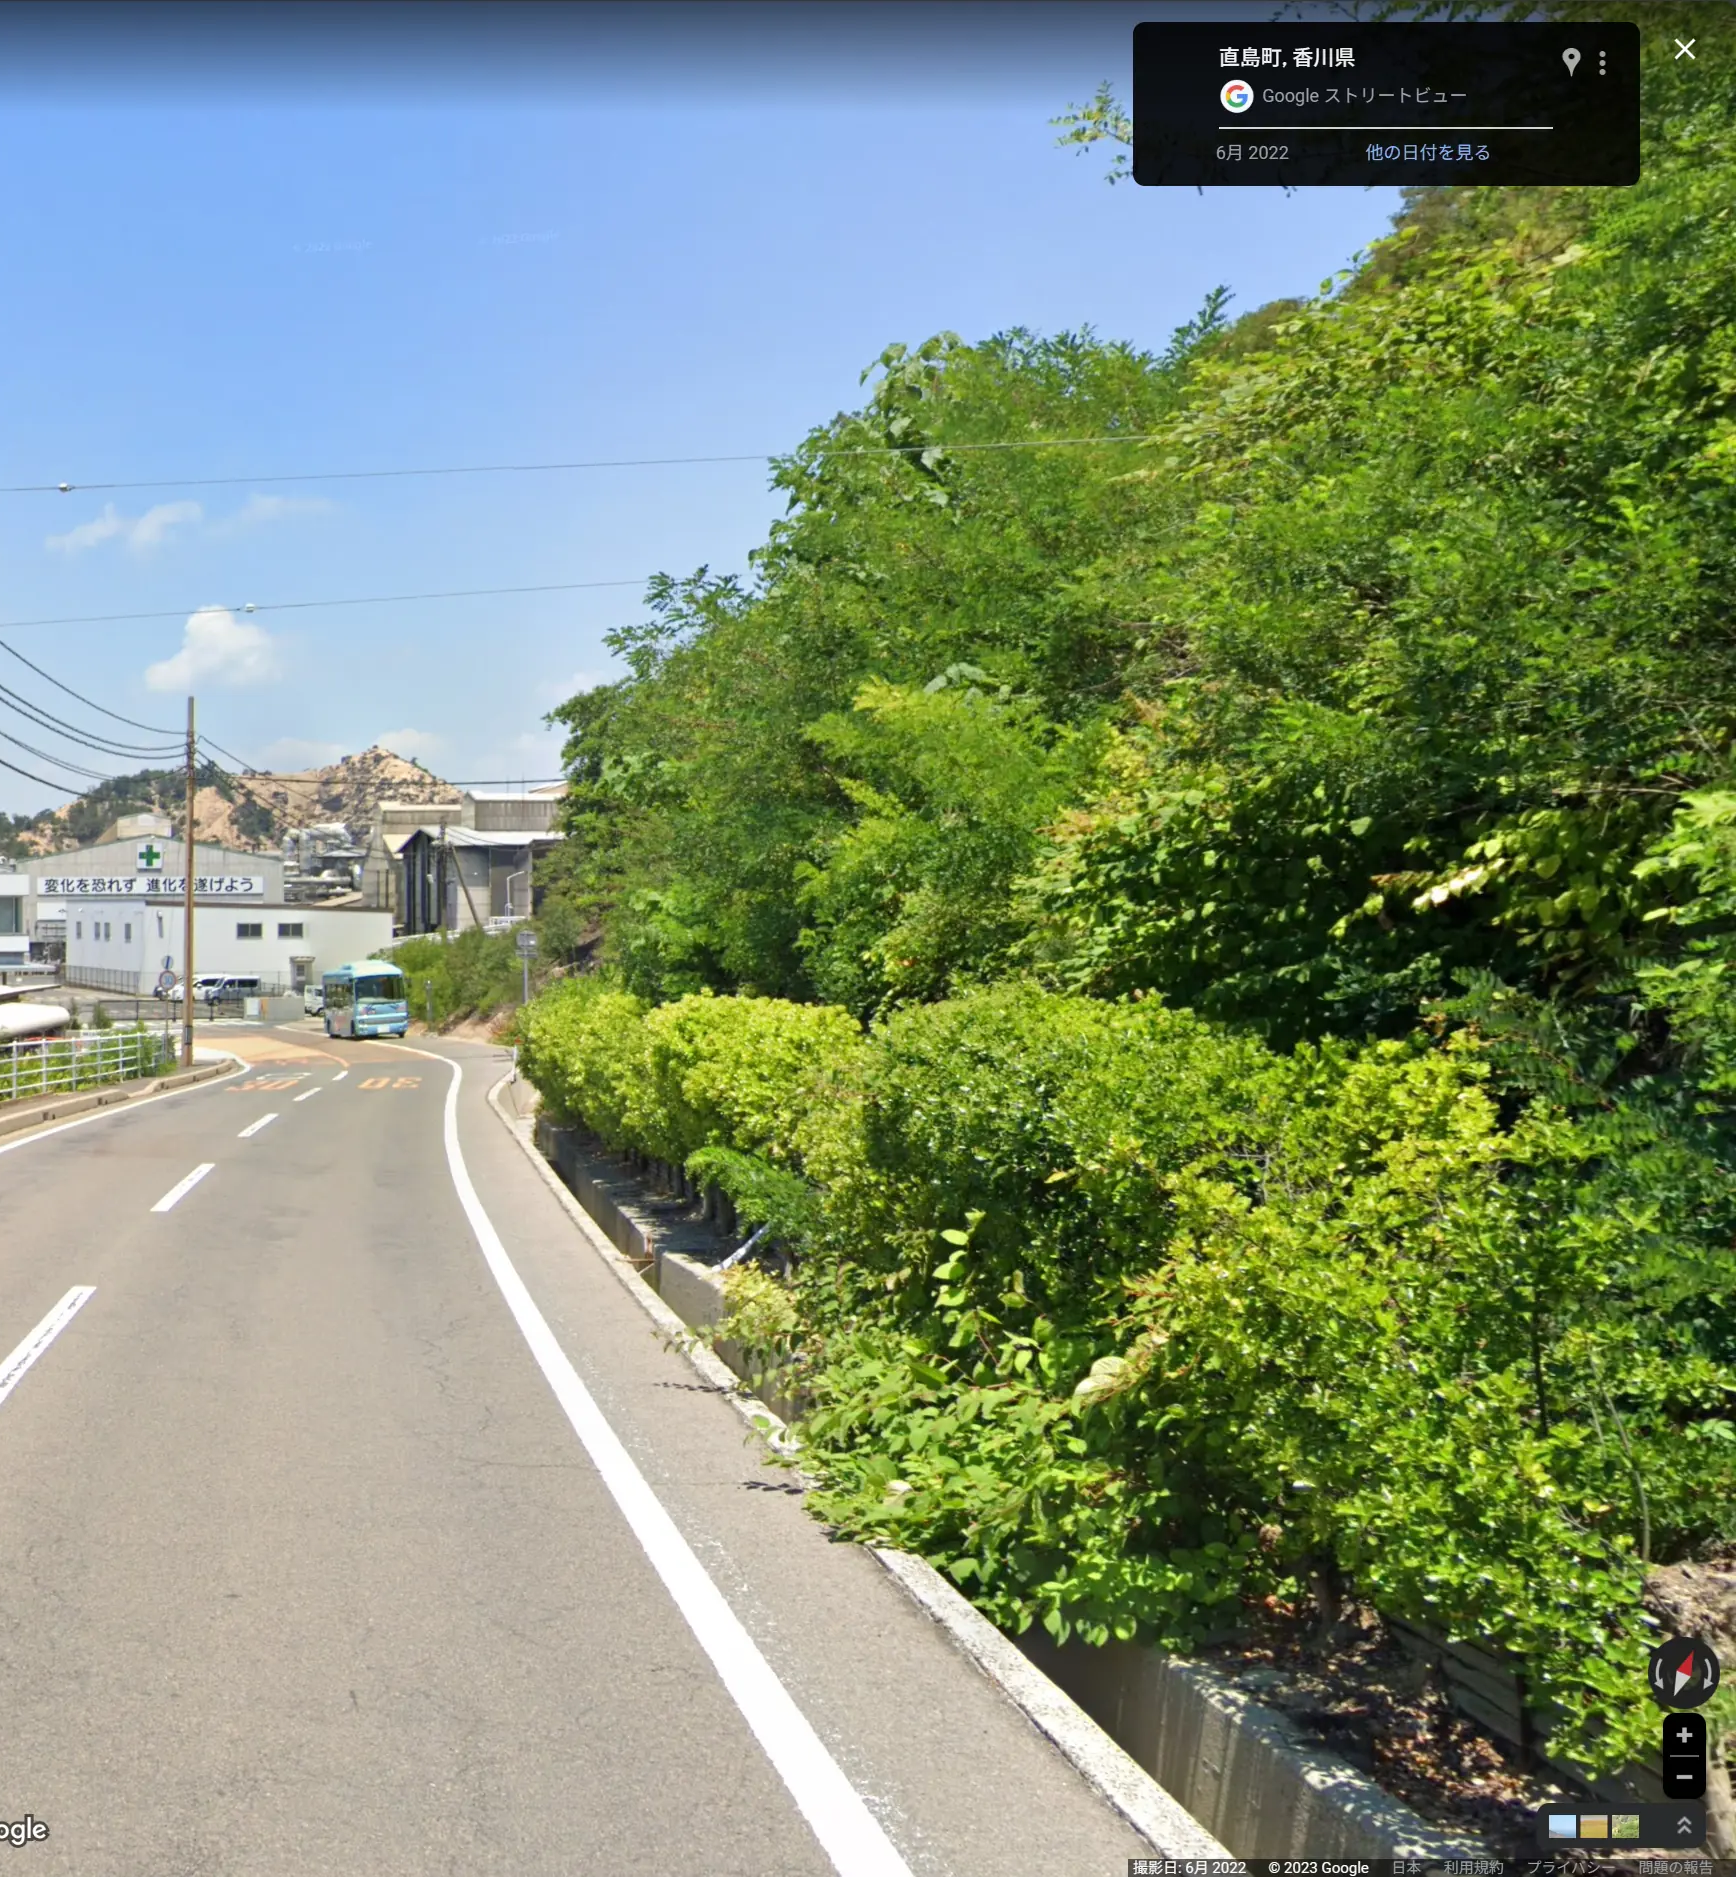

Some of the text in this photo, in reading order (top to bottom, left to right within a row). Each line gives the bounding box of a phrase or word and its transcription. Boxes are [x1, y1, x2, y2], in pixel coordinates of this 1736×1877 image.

[44, 877, 254, 894] 変化を恐れず 進化を遂げよう
